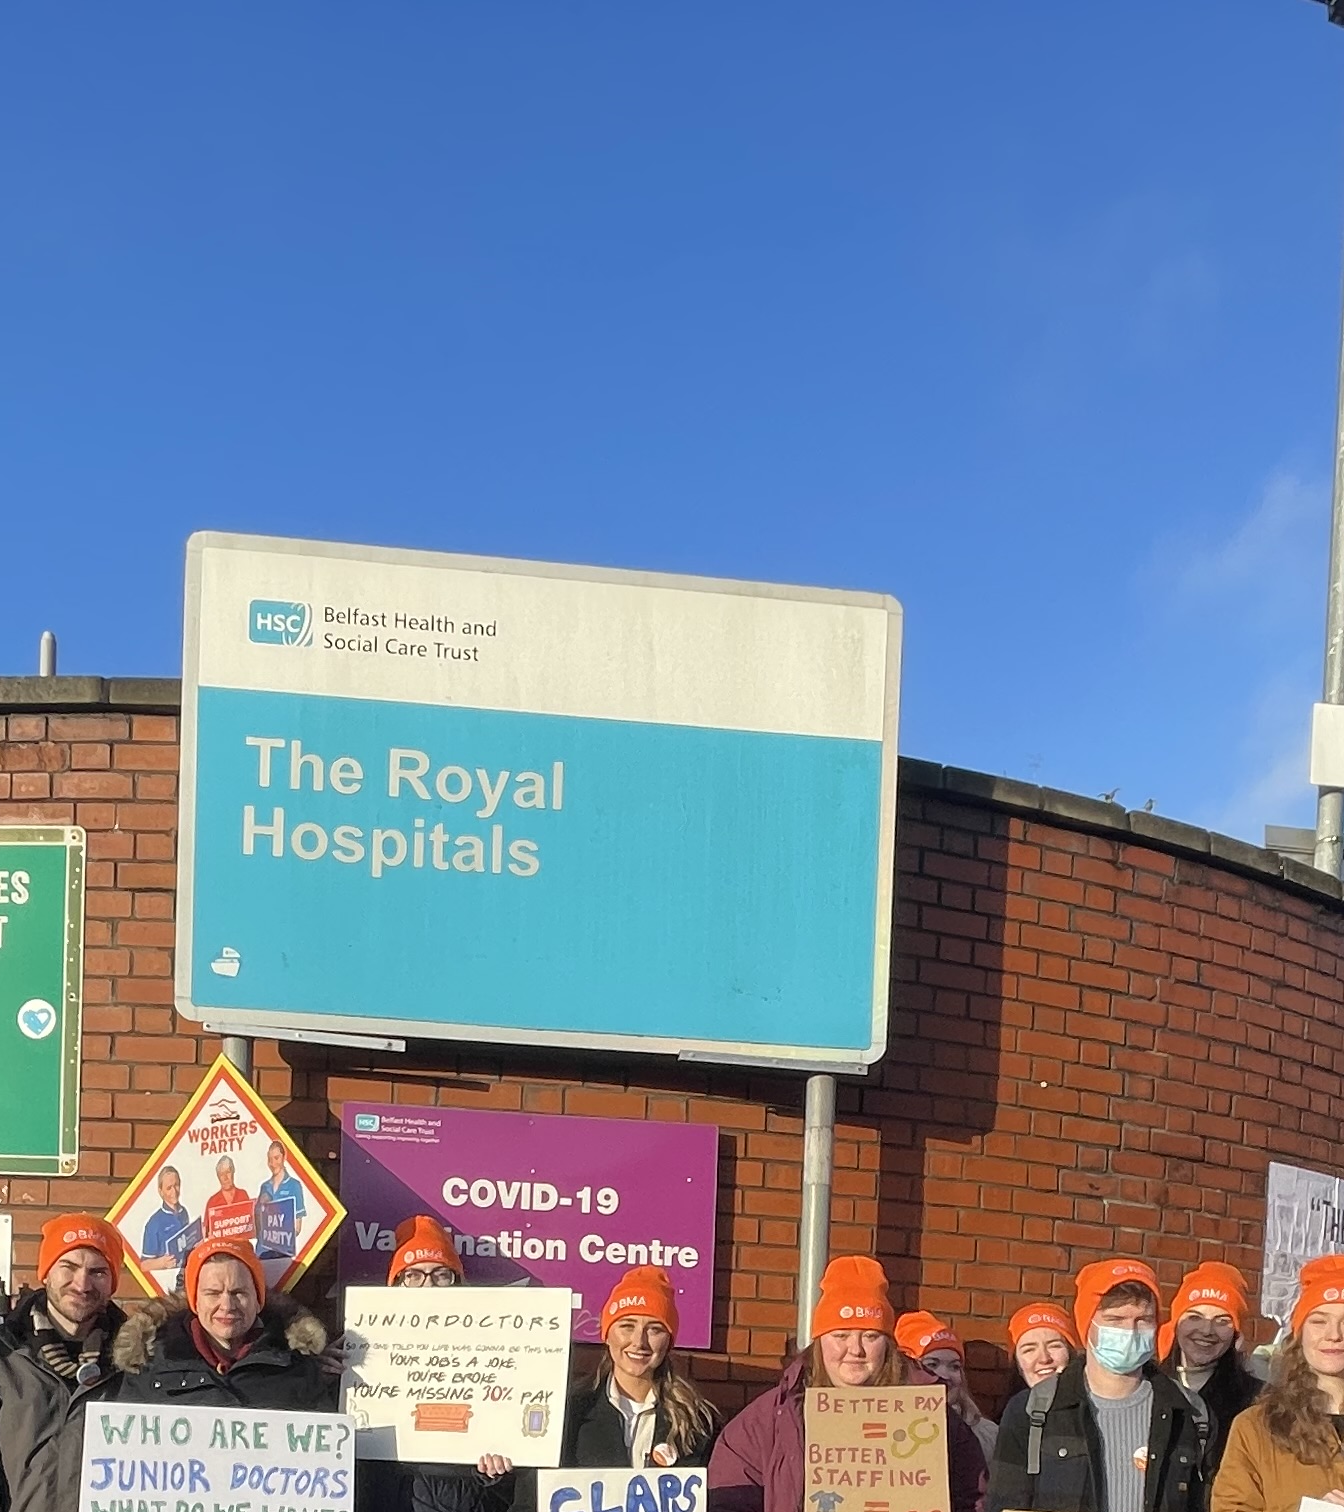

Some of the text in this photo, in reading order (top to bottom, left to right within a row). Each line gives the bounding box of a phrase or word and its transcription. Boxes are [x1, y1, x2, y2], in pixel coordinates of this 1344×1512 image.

[256, 612, 301, 633] HSC
[324, 607, 497, 637] Belfast Health and
[323, 633, 479, 662] Social Care Trust
[246, 736, 564, 819] The Royal
[241, 805, 540, 878] Hospitals
[187, 1120, 258, 1144] WORKERS
[200, 1137, 245, 1156] PARTY
[442, 1177, 619, 1215] COVID-19
[214, 1214, 251, 1229] SUPPORT
[267, 1213, 285, 1228] PAY
[263, 1229, 292, 1246] PARITY
[355, 1221, 700, 1269] Vanation Centre
[619, 1296, 646, 1309] BMA
[1201, 1288, 1228, 1302] BMA
[389, 1352, 420, 1367] YOUR
[466, 1356, 479, 1367] A
[451, 1372, 497, 1384] BROKE
[406, 1386, 474, 1401] MISSING
[482, 1385, 514, 1402] 30%
[520, 1390, 554, 1405] PAY
[817, 1392, 945, 1414] BETTER PAY
[100, 1414, 351, 1460] WHO ARE WE?
[809, 1443, 887, 1465] BETTER
[90, 1458, 349, 1500] JUNIOR DOCTORS
[812, 1466, 931, 1487] STAFFING
